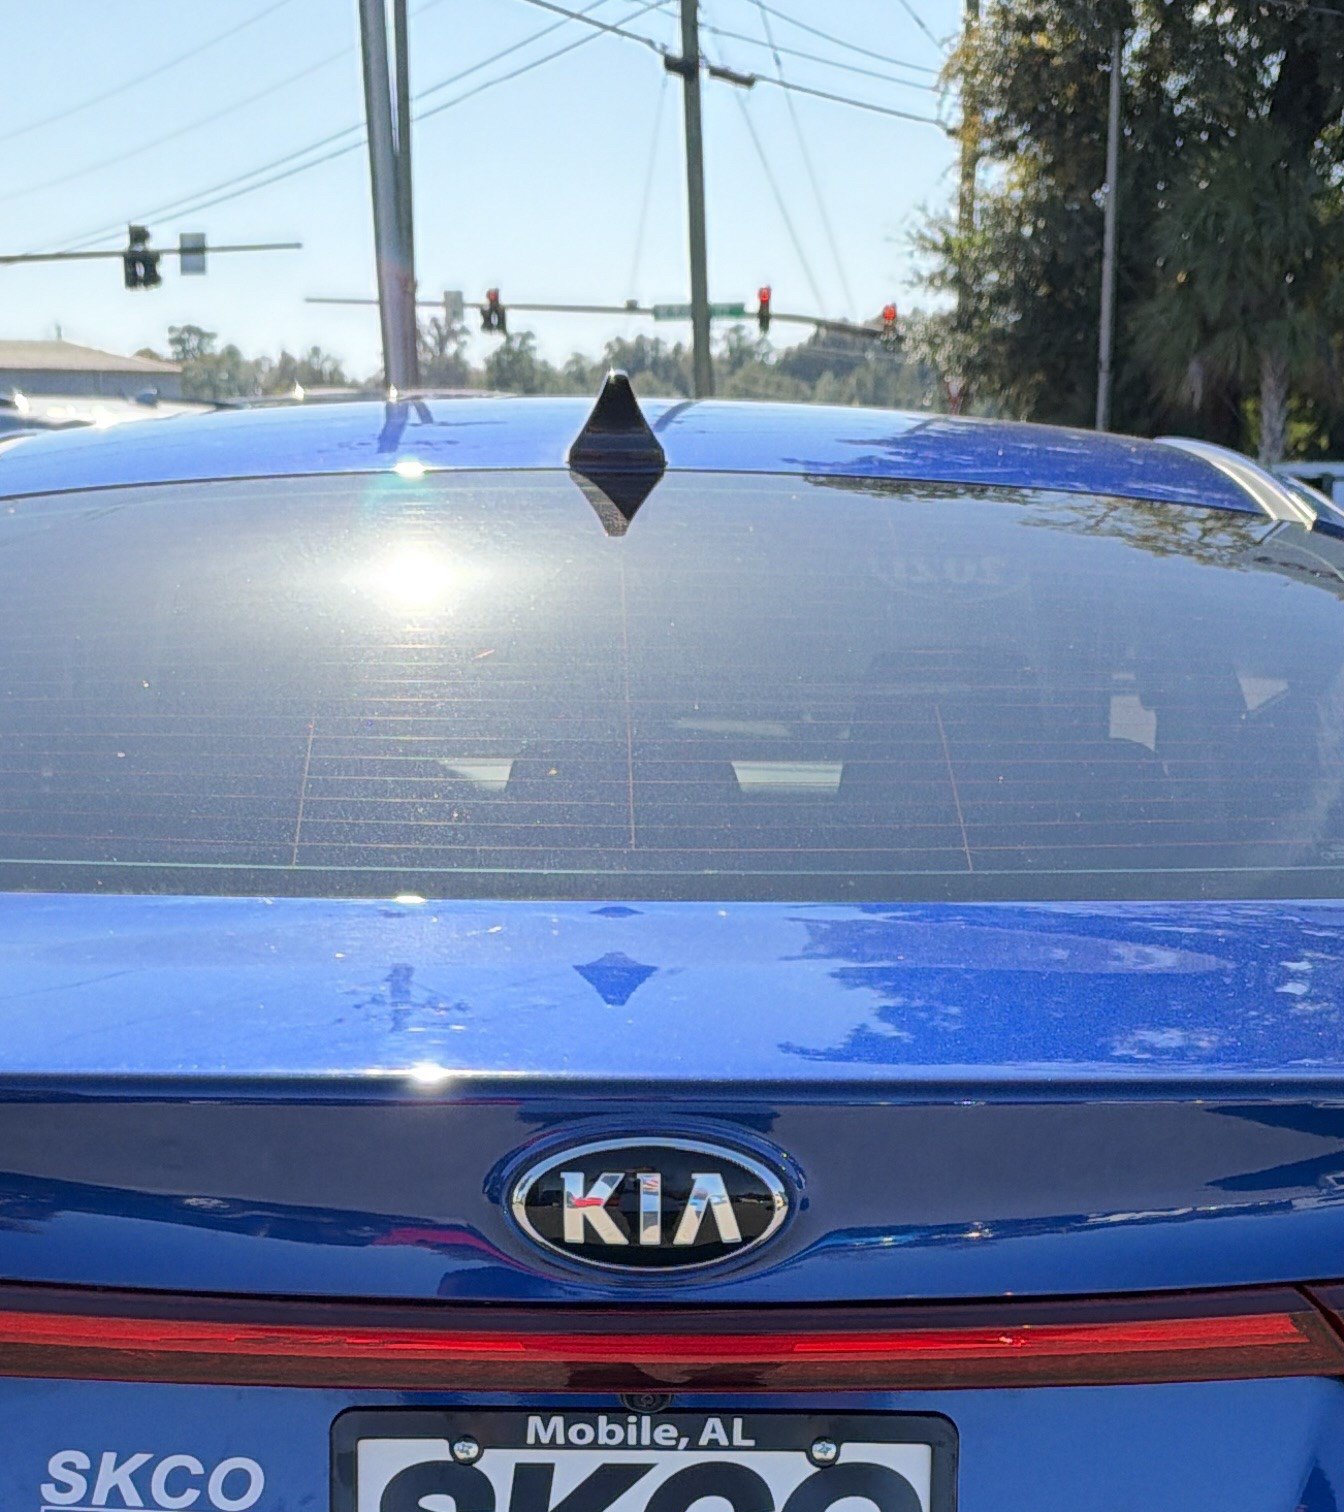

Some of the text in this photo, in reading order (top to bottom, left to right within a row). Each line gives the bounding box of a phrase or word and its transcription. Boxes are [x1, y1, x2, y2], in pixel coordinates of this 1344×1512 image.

[559, 1171, 743, 1246] KIA
[526, 1414, 756, 1450] Mobile, AL
[39, 1449, 265, 1512] SKCO
